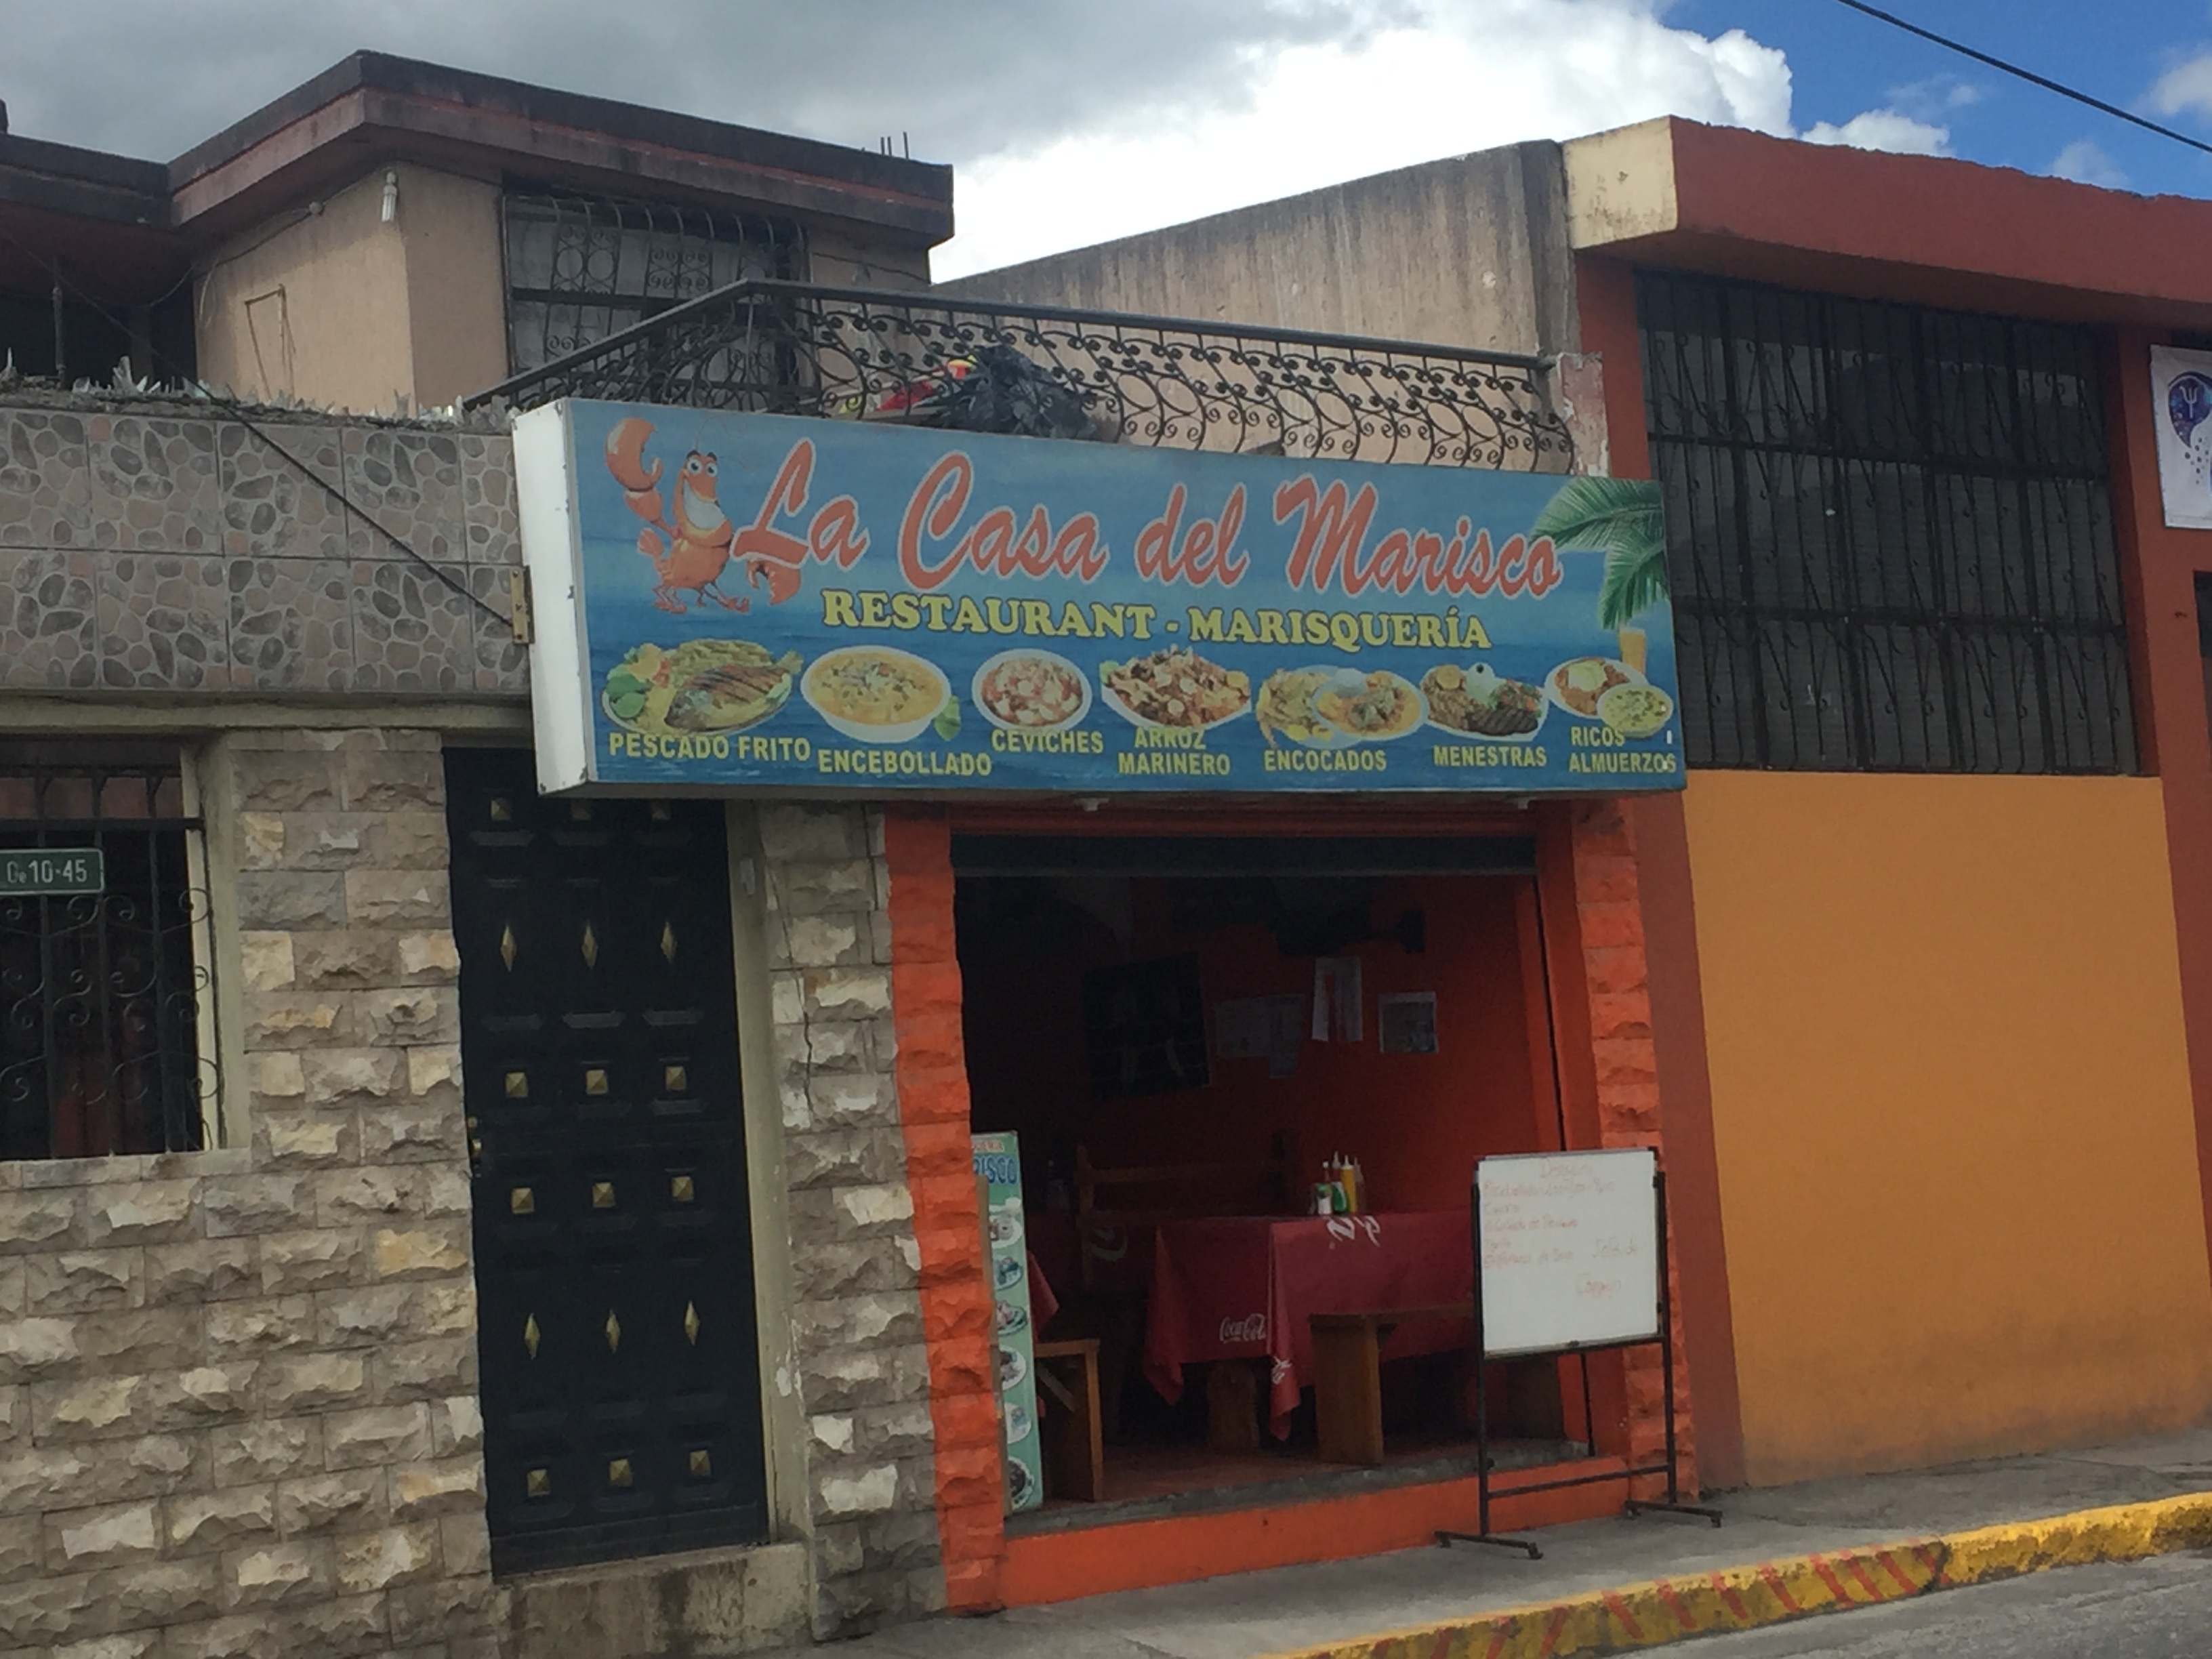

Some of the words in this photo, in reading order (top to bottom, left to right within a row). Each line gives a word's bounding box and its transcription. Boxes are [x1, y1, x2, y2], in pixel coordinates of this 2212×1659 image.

[731, 437, 870, 571] La
[898, 450, 1110, 591] Casa
[1134, 481, 1249, 587] del
[1273, 474, 1563, 599] Marisco
[821, 589, 1155, 640] RESTAURANT
[1187, 607, 1492, 652] MARISQUERÍA
[609, 733, 729, 759] PESCADO
[739, 736, 811, 761] FRITO
[991, 729, 1103, 754] CEVICHES
[1134, 727, 1206, 750] ARROZ
[1571, 726, 1625, 747] RICOS
[818, 749, 991, 777] ENCEBOLLADO
[1118, 752, 1231, 775] MARINERO
[1264, 750, 1387, 771] ENCOCADOS
[1433, 745, 1547, 766] MENESTRAS
[1569, 753, 1677, 773] ALMUERZOS
